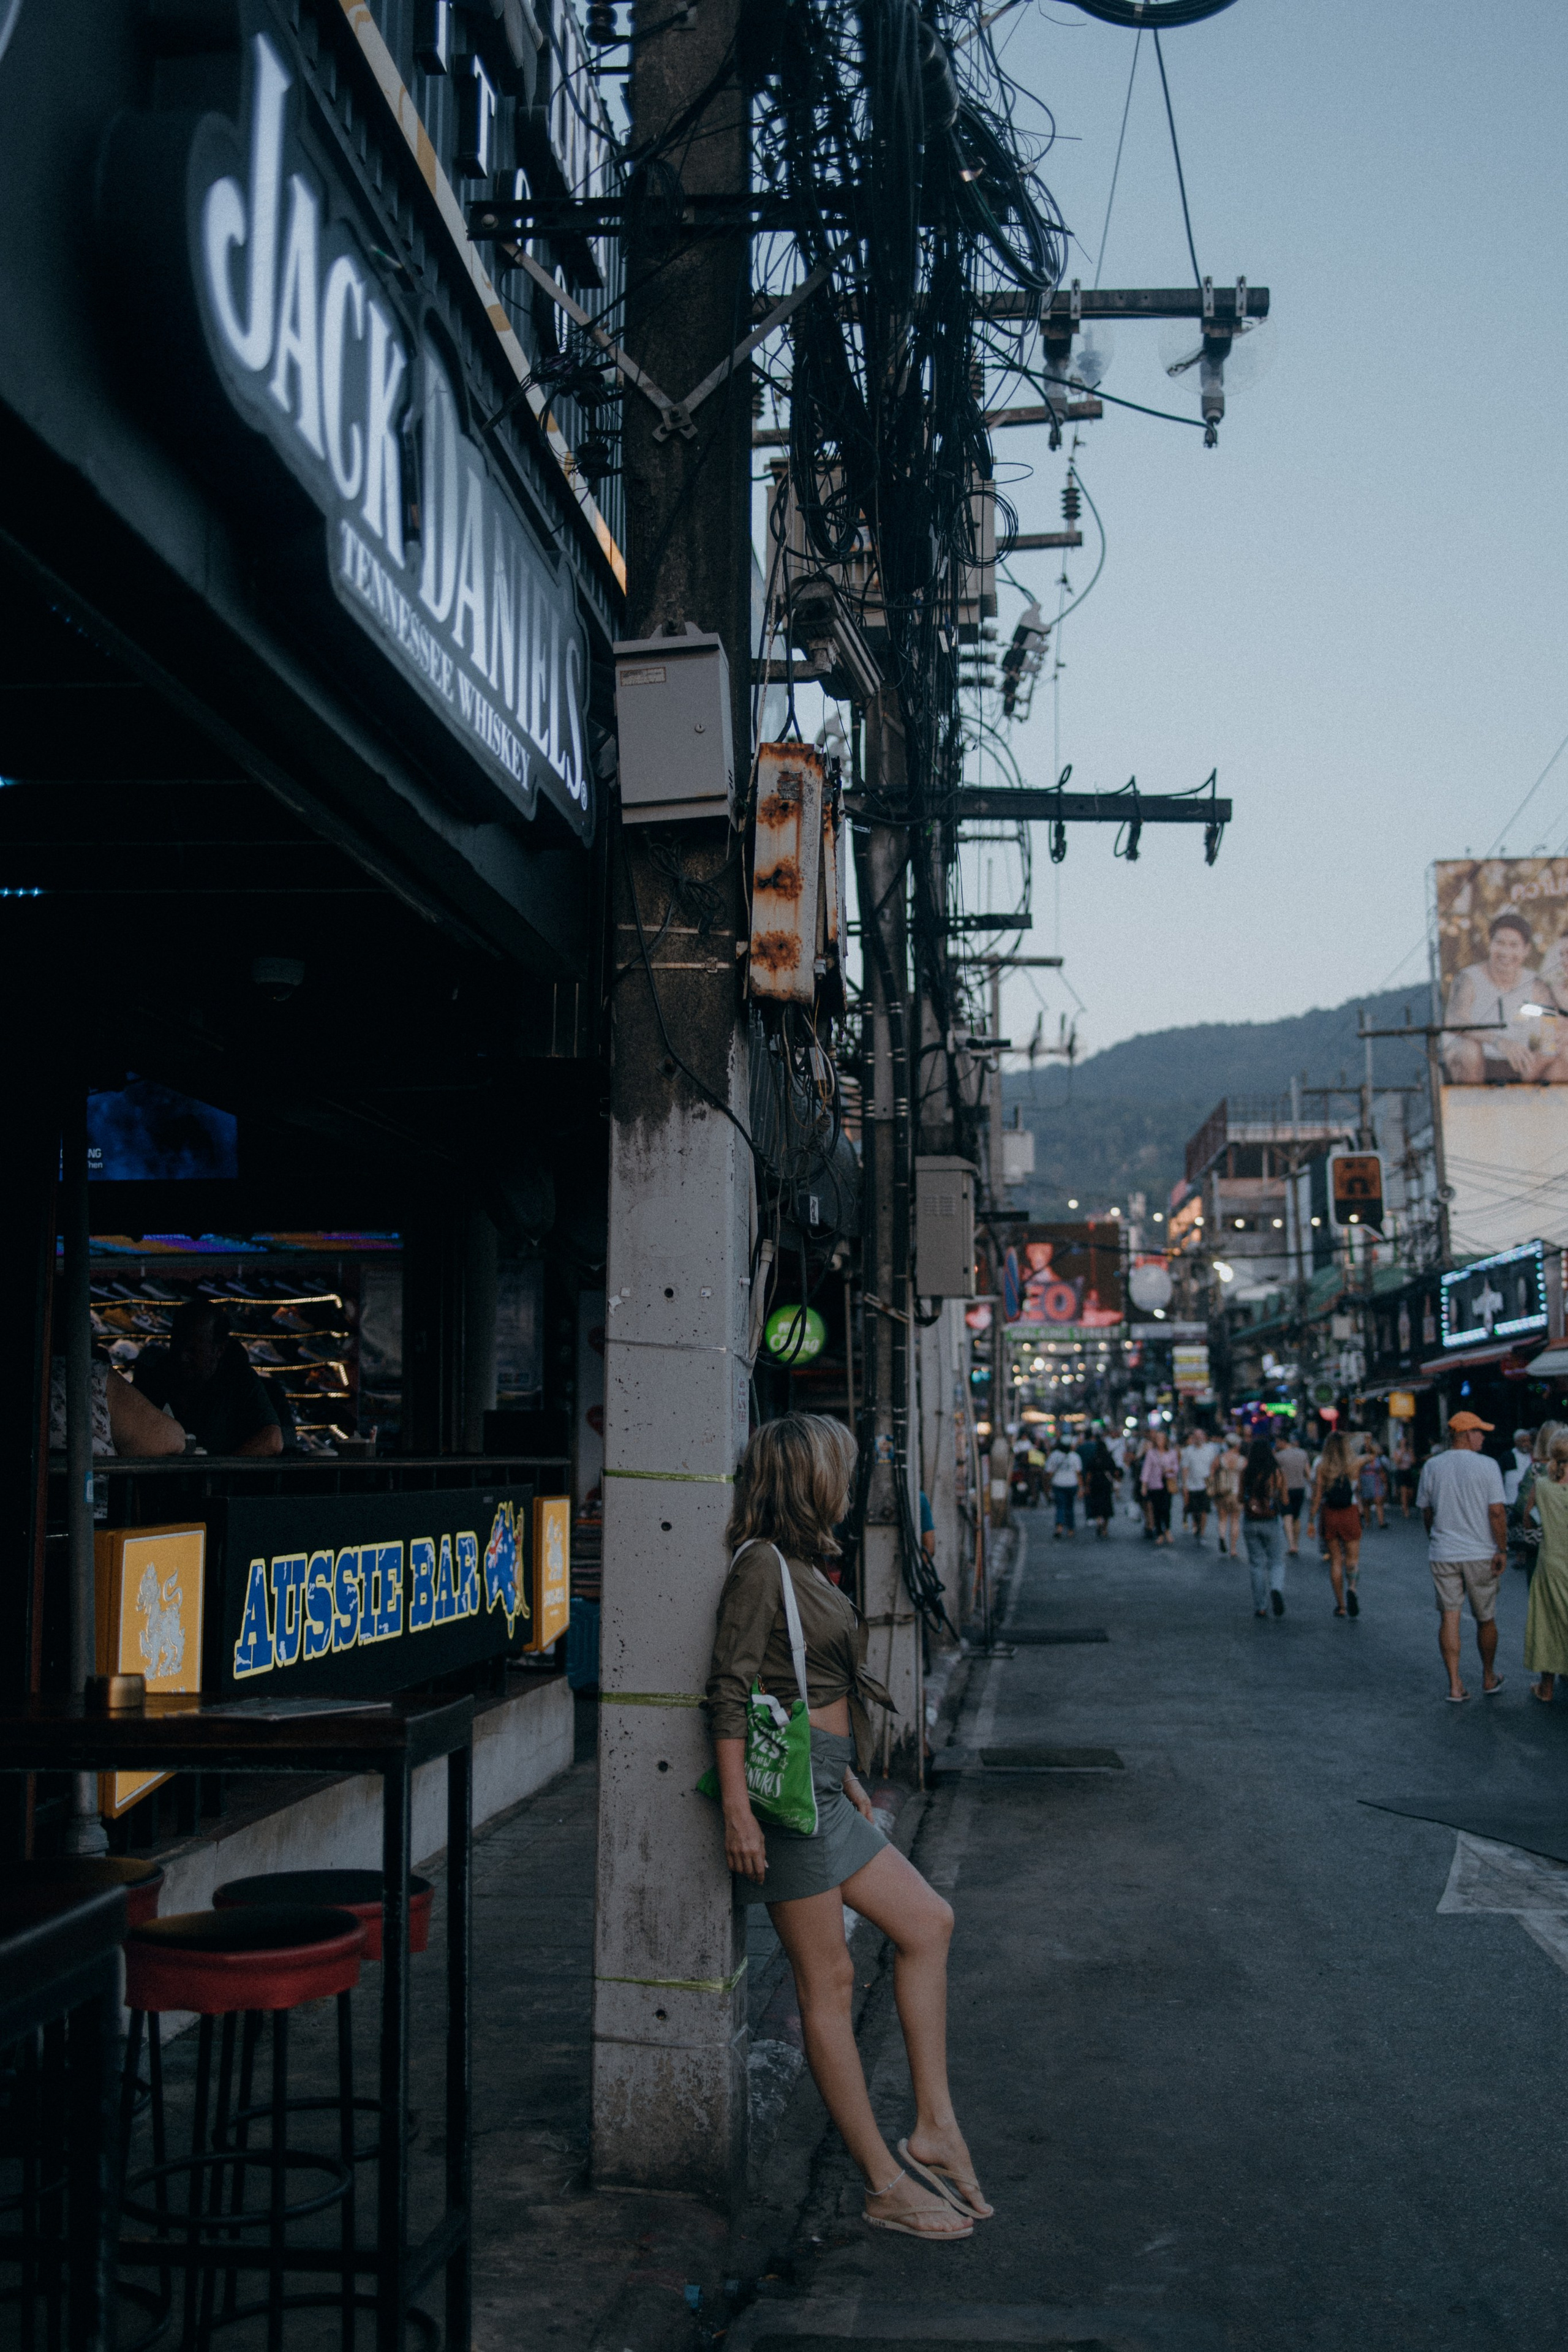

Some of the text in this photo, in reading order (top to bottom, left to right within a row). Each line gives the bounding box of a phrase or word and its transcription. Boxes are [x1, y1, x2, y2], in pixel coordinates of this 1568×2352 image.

[204, 33, 406, 570] JACK
[340, 518, 530, 791] TENNESSEE WHISKEY
[234, 1530, 481, 1680] AUSSIE BAR
[751, 1730, 781, 1759] YES
